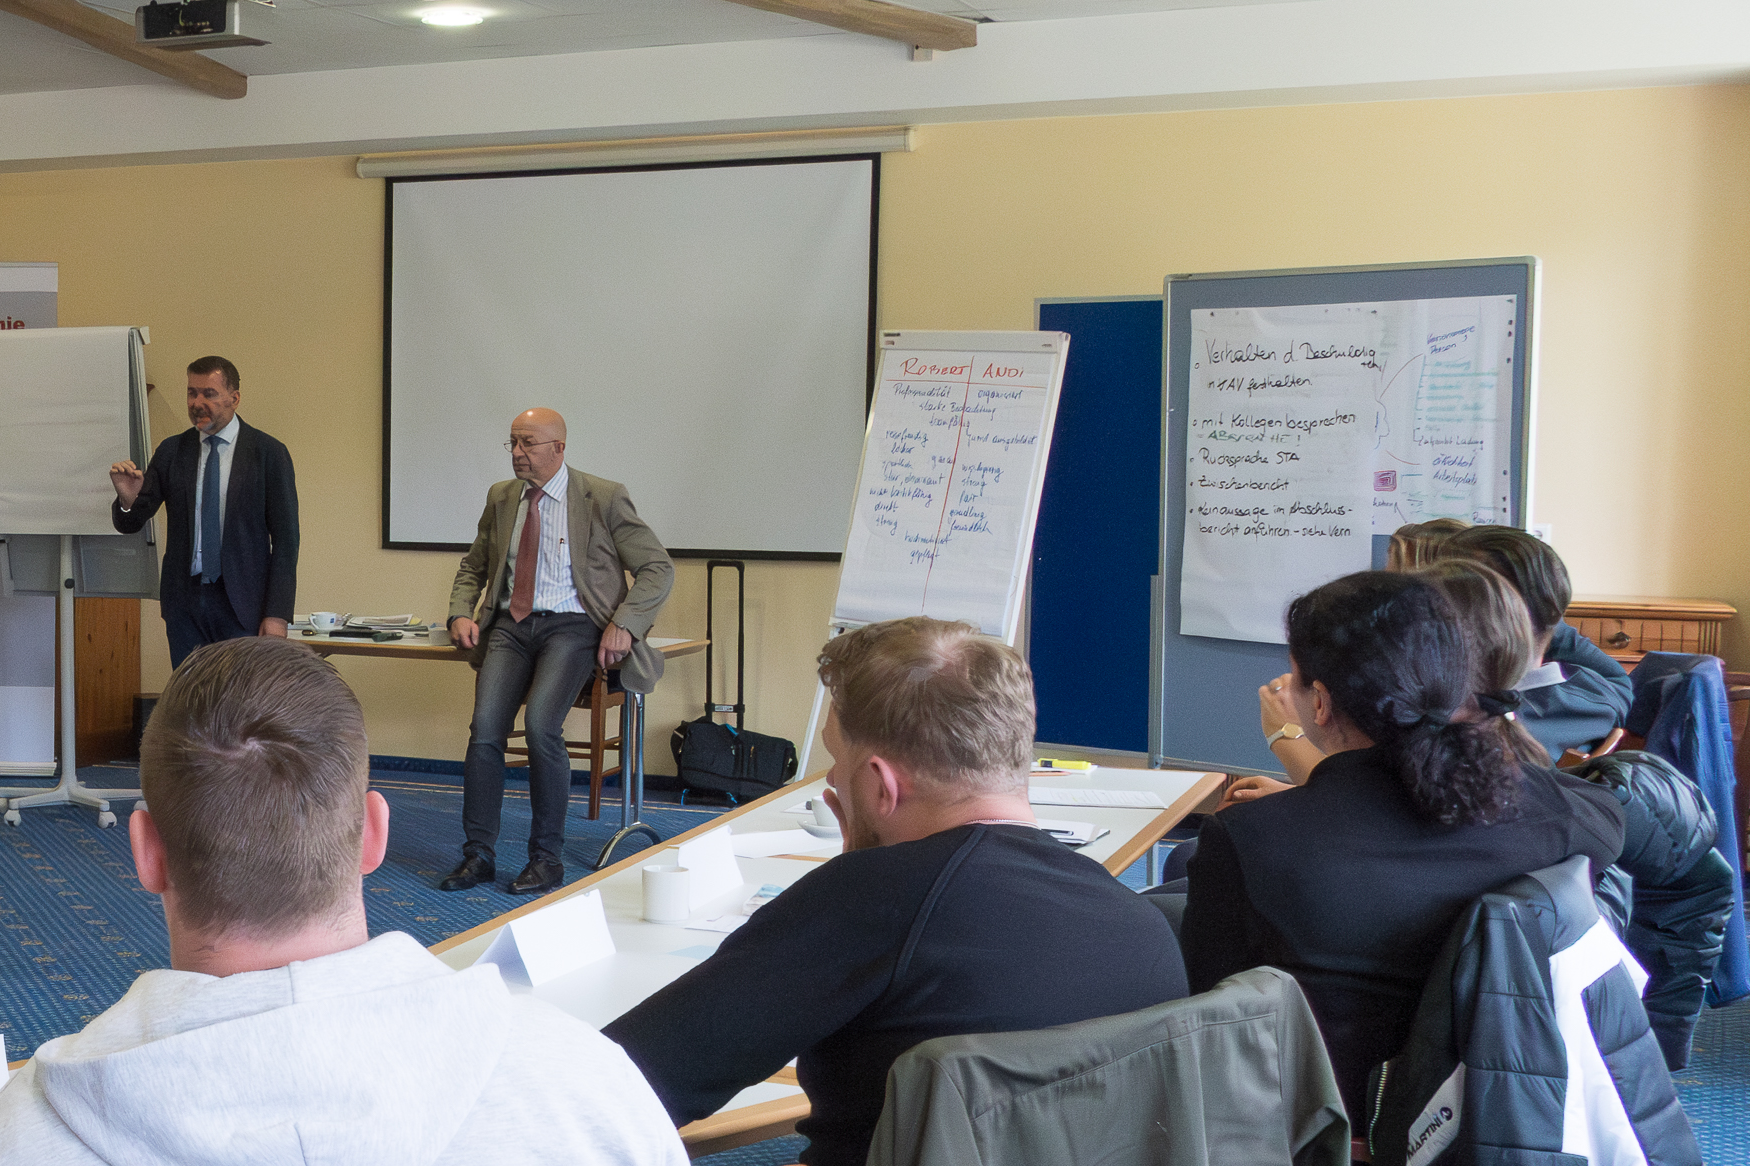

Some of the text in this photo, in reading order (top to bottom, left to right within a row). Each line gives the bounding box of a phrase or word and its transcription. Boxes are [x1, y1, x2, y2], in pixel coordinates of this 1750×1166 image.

[1205, 339, 1276, 364] Verhalten
[900, 357, 970, 377] ROBERT
[1202, 412, 1224, 428] mit
[1231, 413, 1282, 432] Kollegen
[1275, 451, 1301, 465] STA
[1199, 522, 1240, 537] bericht
[1407, 1116, 1443, 1160] MARTINI
